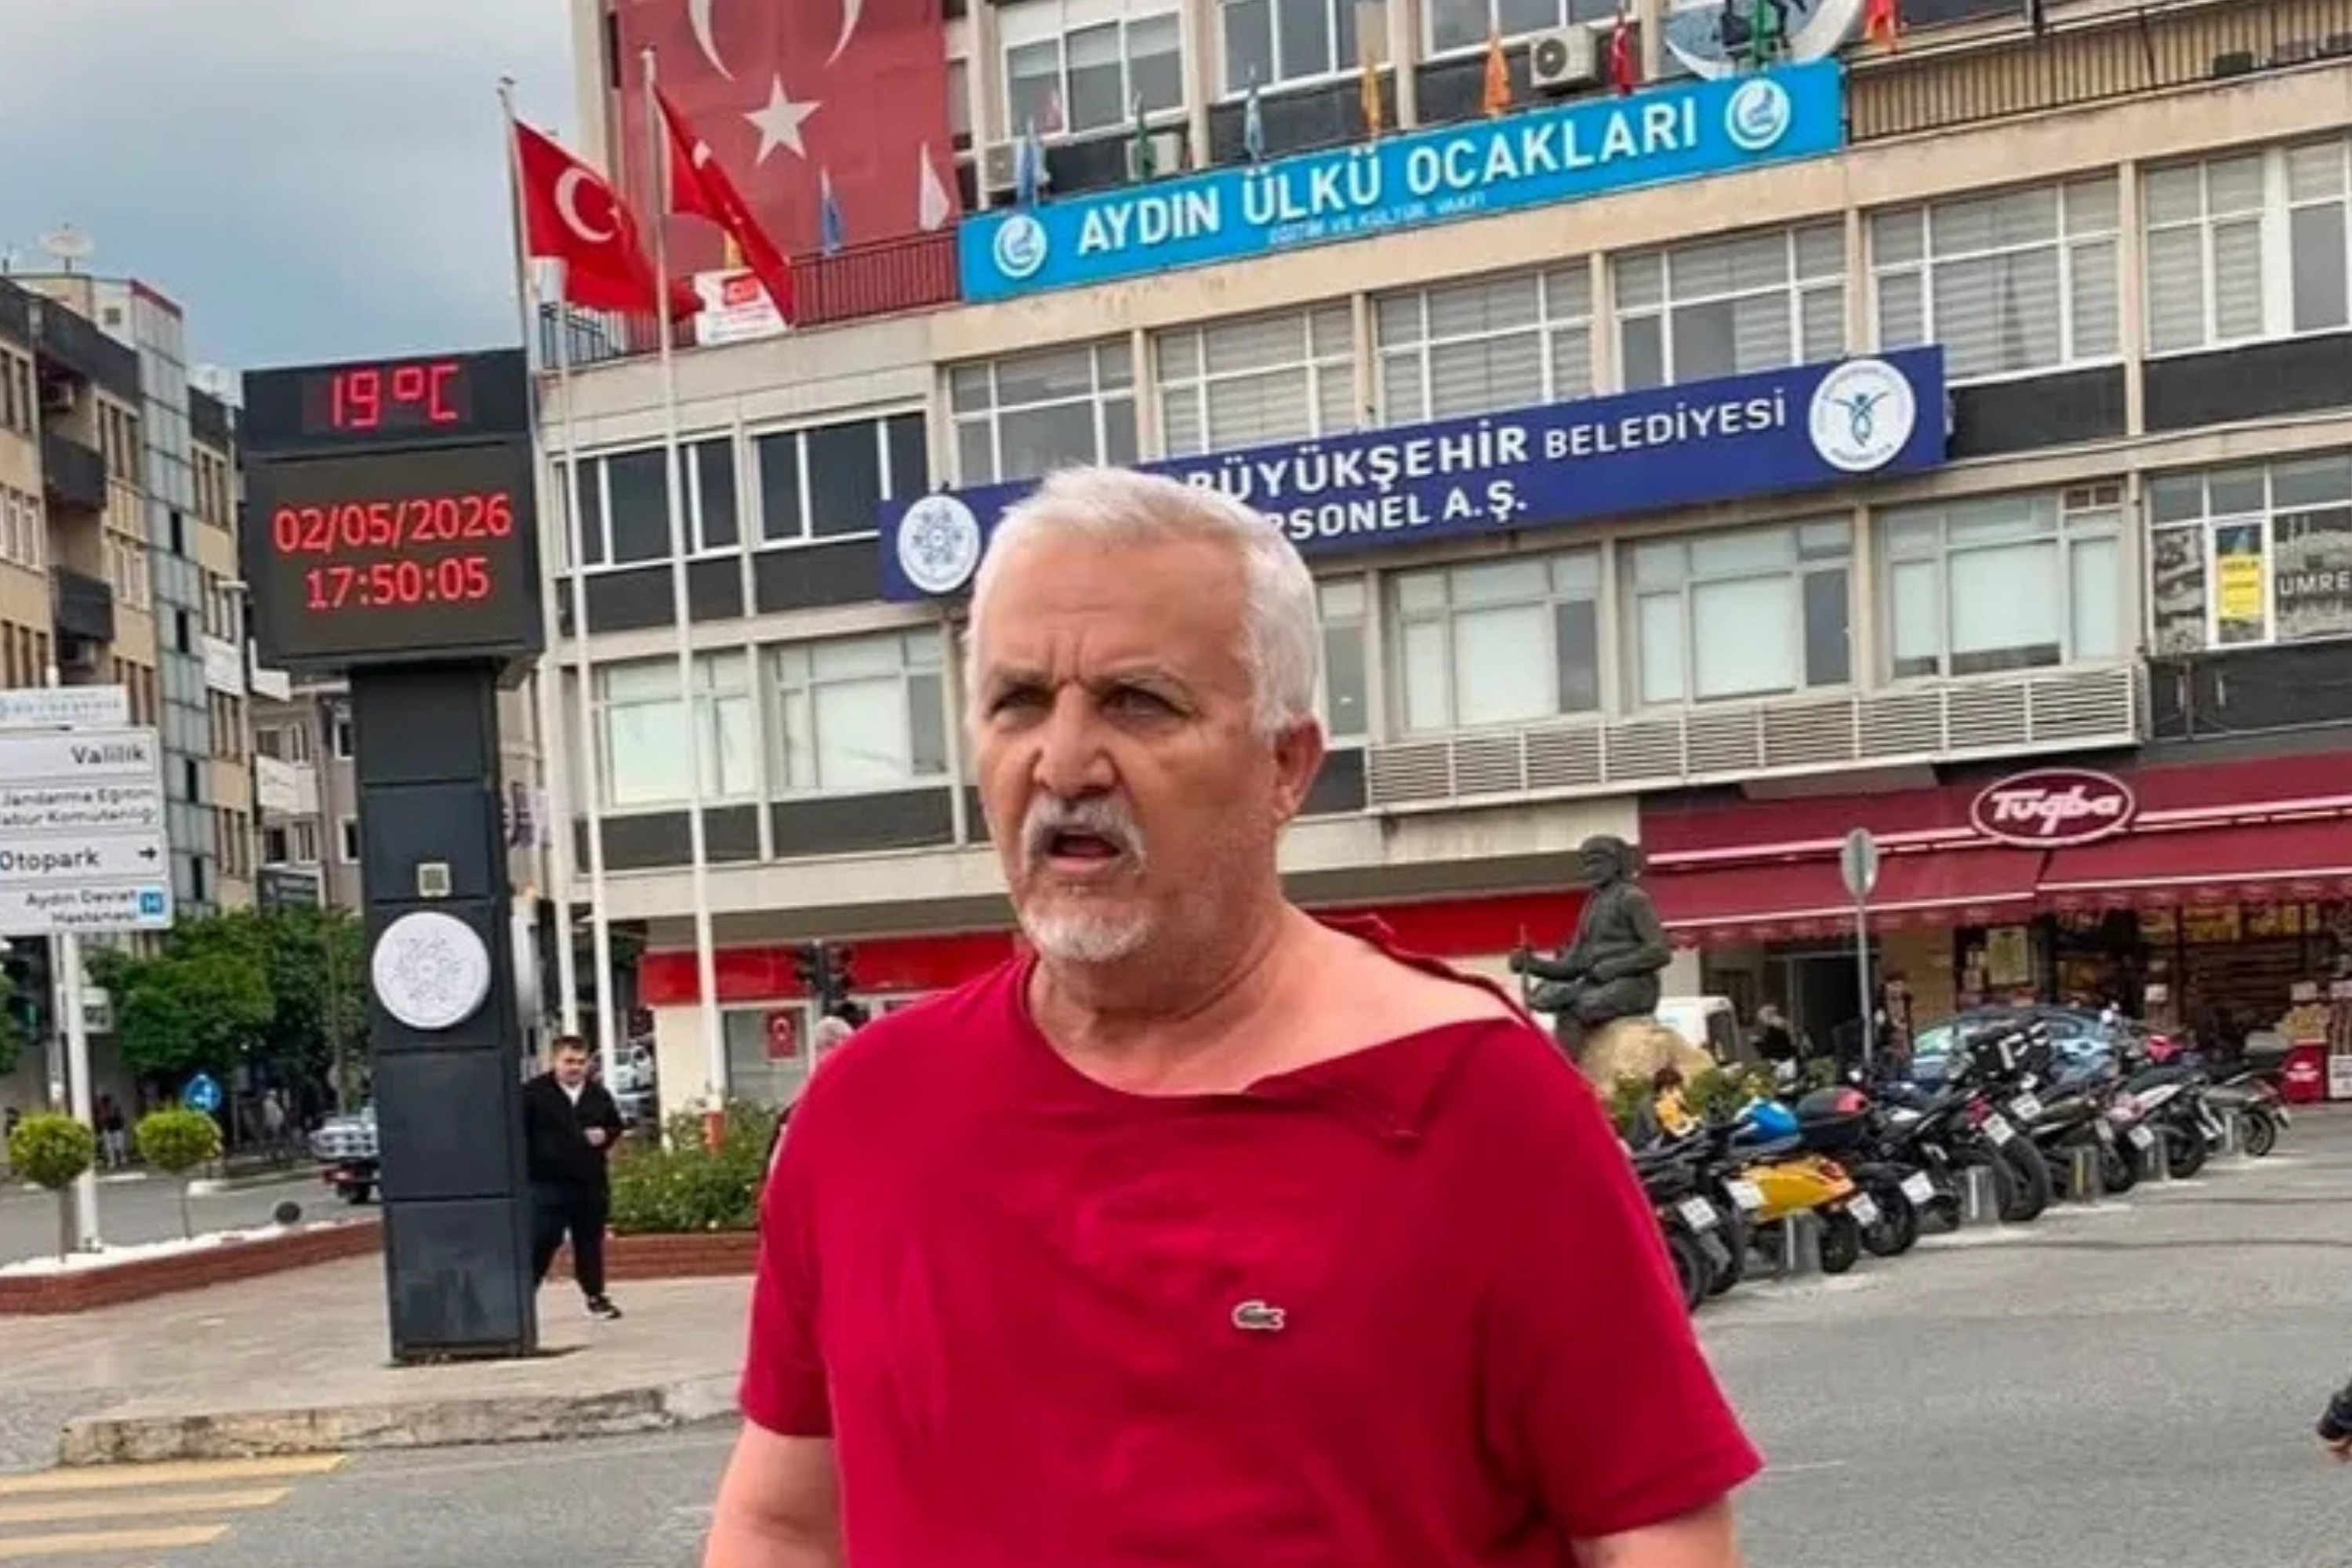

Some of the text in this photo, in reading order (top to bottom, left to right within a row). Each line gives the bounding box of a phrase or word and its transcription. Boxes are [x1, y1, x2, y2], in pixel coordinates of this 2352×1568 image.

[1077, 96, 1698, 256] AYDIN ÜLKÜ OCAKLARI
[1187, 389, 1786, 503] BÜYÜKŞEHİR BELEDİYESİ
[274, 492, 514, 554] 02/05/2026
[1264, 481, 1528, 540] RSONEL A.Ş.
[307, 557, 489, 609] 17:50:05
[2280, 571, 2351, 596] UMRE
[71, 746, 147, 764] Valilik
[0, 811, 42, 826] abur
[0, 847, 100, 874] Otopark
